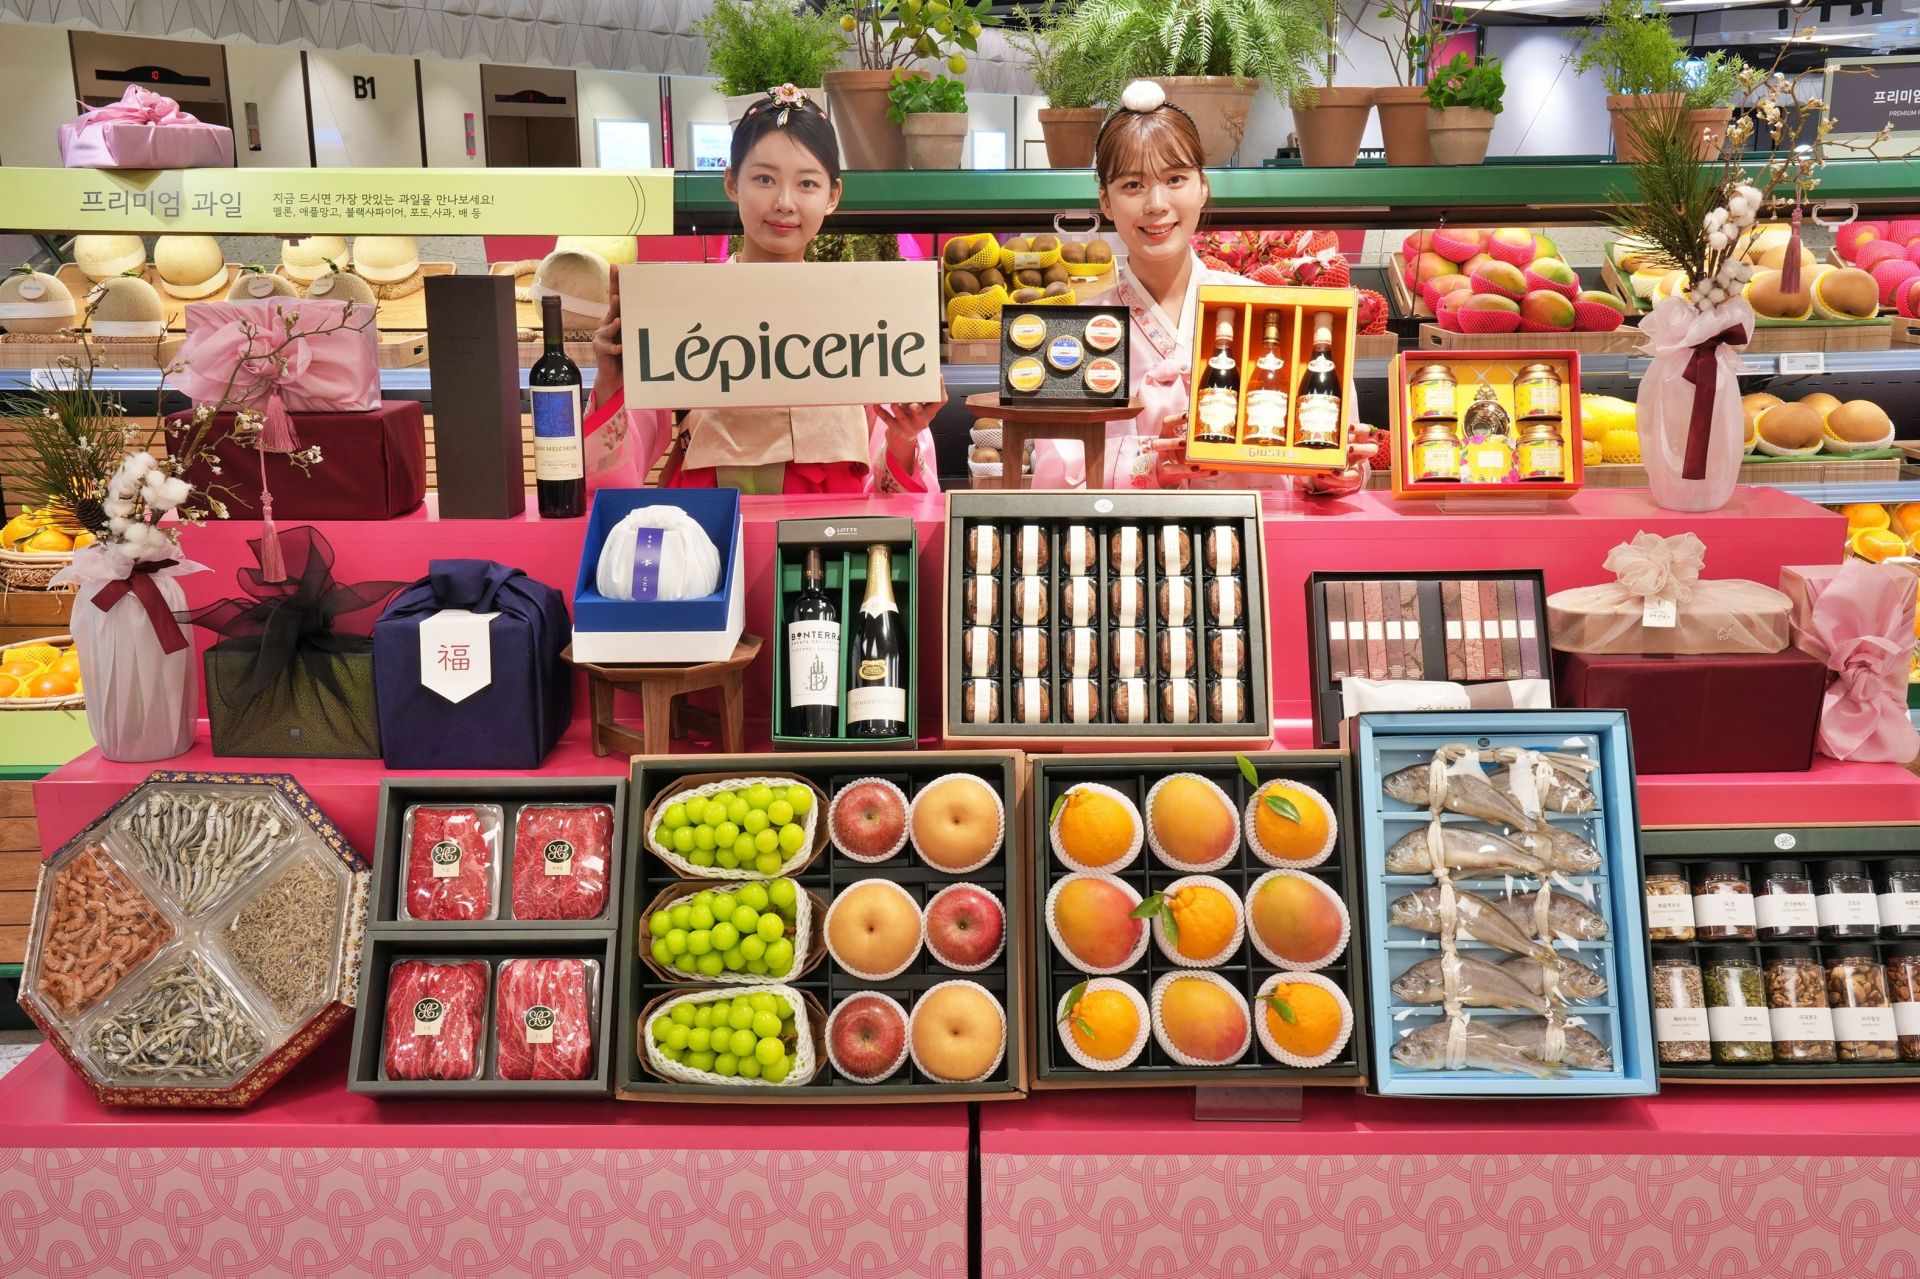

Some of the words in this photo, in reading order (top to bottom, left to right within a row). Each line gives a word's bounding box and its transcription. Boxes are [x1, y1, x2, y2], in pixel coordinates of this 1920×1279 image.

[353, 75, 377, 99] B1
[80, 190, 180, 218] 프리미엄
[192, 191, 242, 218] 과일
[273, 192, 295, 205] 지금
[299, 193, 331, 205] 드시면
[335, 193, 357, 206] 가장
[362, 193, 395, 206] 맛있는
[399, 193, 432, 206] 과일을
[436, 194, 494, 206] 만나보세요!
[273, 207, 296, 218] 멜론,
[299, 207, 342, 218] 애플망고,
[345, 207, 407, 219] 블랙사파이어,
[458, 207, 468, 218] 배
[471, 207, 481, 219] 등
[638, 320, 926, 392] Lépicerie
[1249, 448, 1286, 458] GIUSTI
[437, 644, 470, 671] 福
